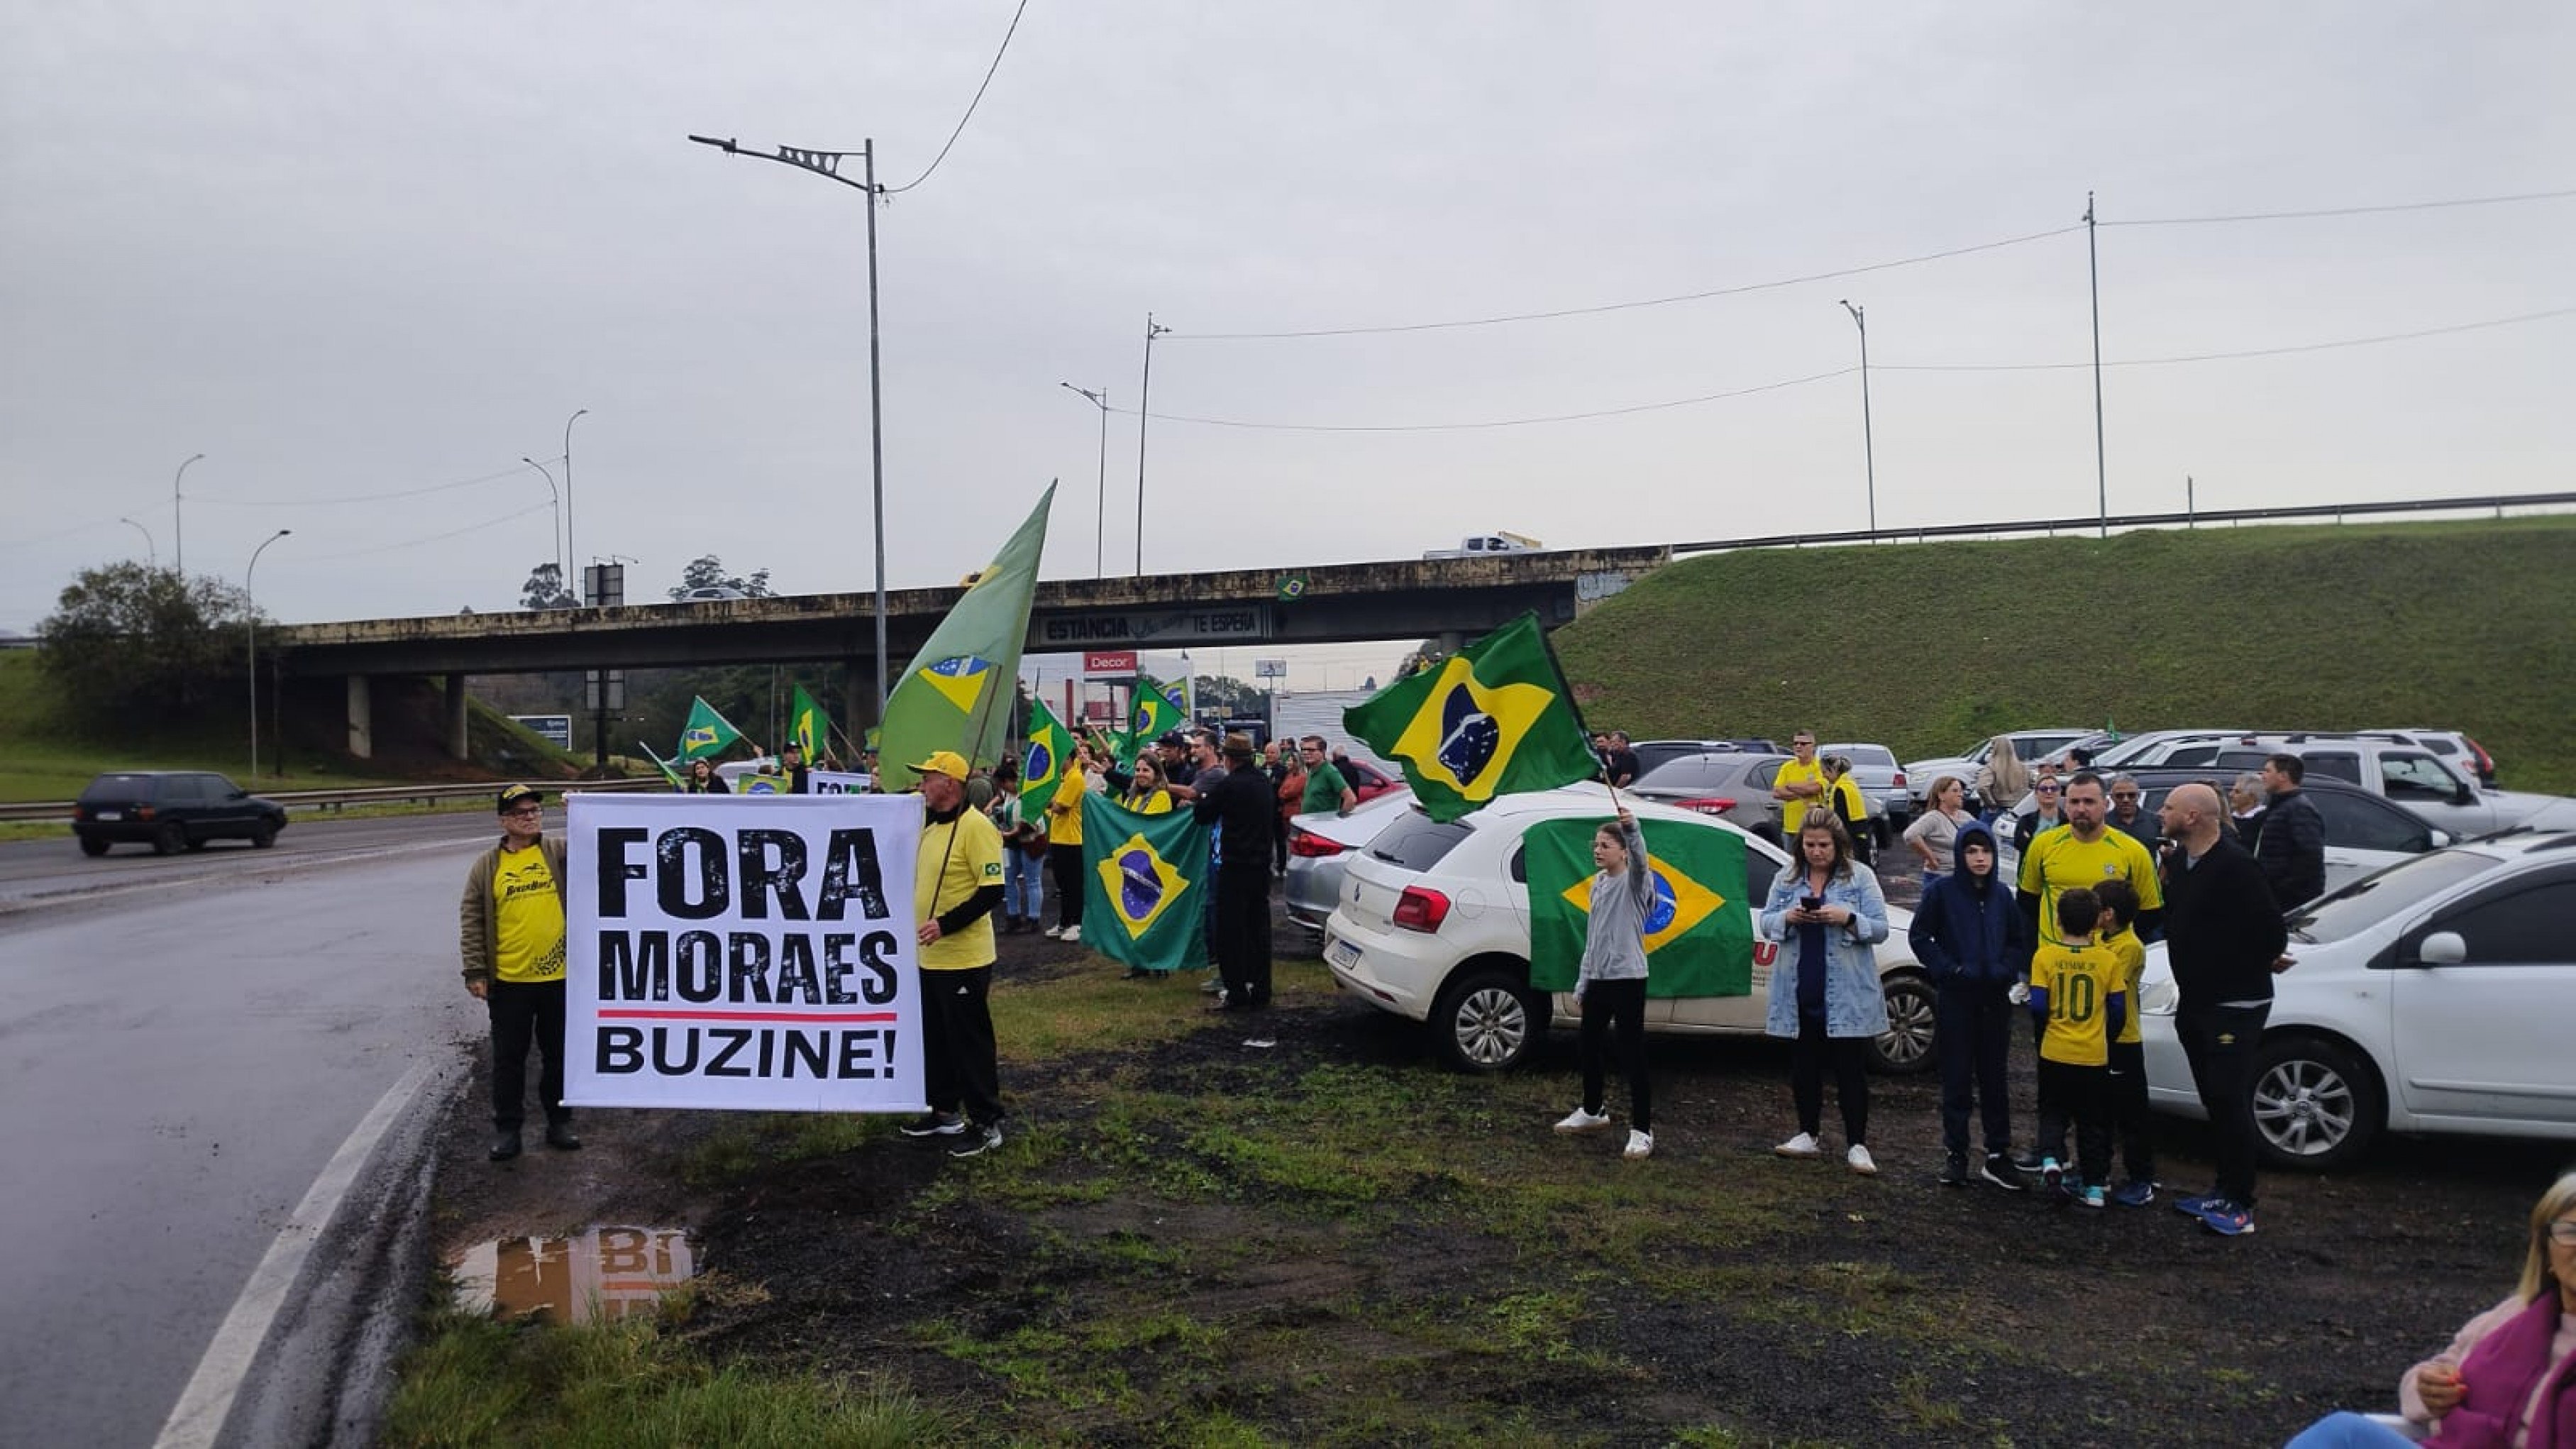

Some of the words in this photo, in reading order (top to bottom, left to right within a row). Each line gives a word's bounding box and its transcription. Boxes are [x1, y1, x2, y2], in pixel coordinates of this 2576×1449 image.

[597, 827, 890, 921] FORA
[598, 930, 897, 1006] MORAES
[2052, 972, 2094, 1022] 10
[596, 1026, 896, 1079] BUZINE!
